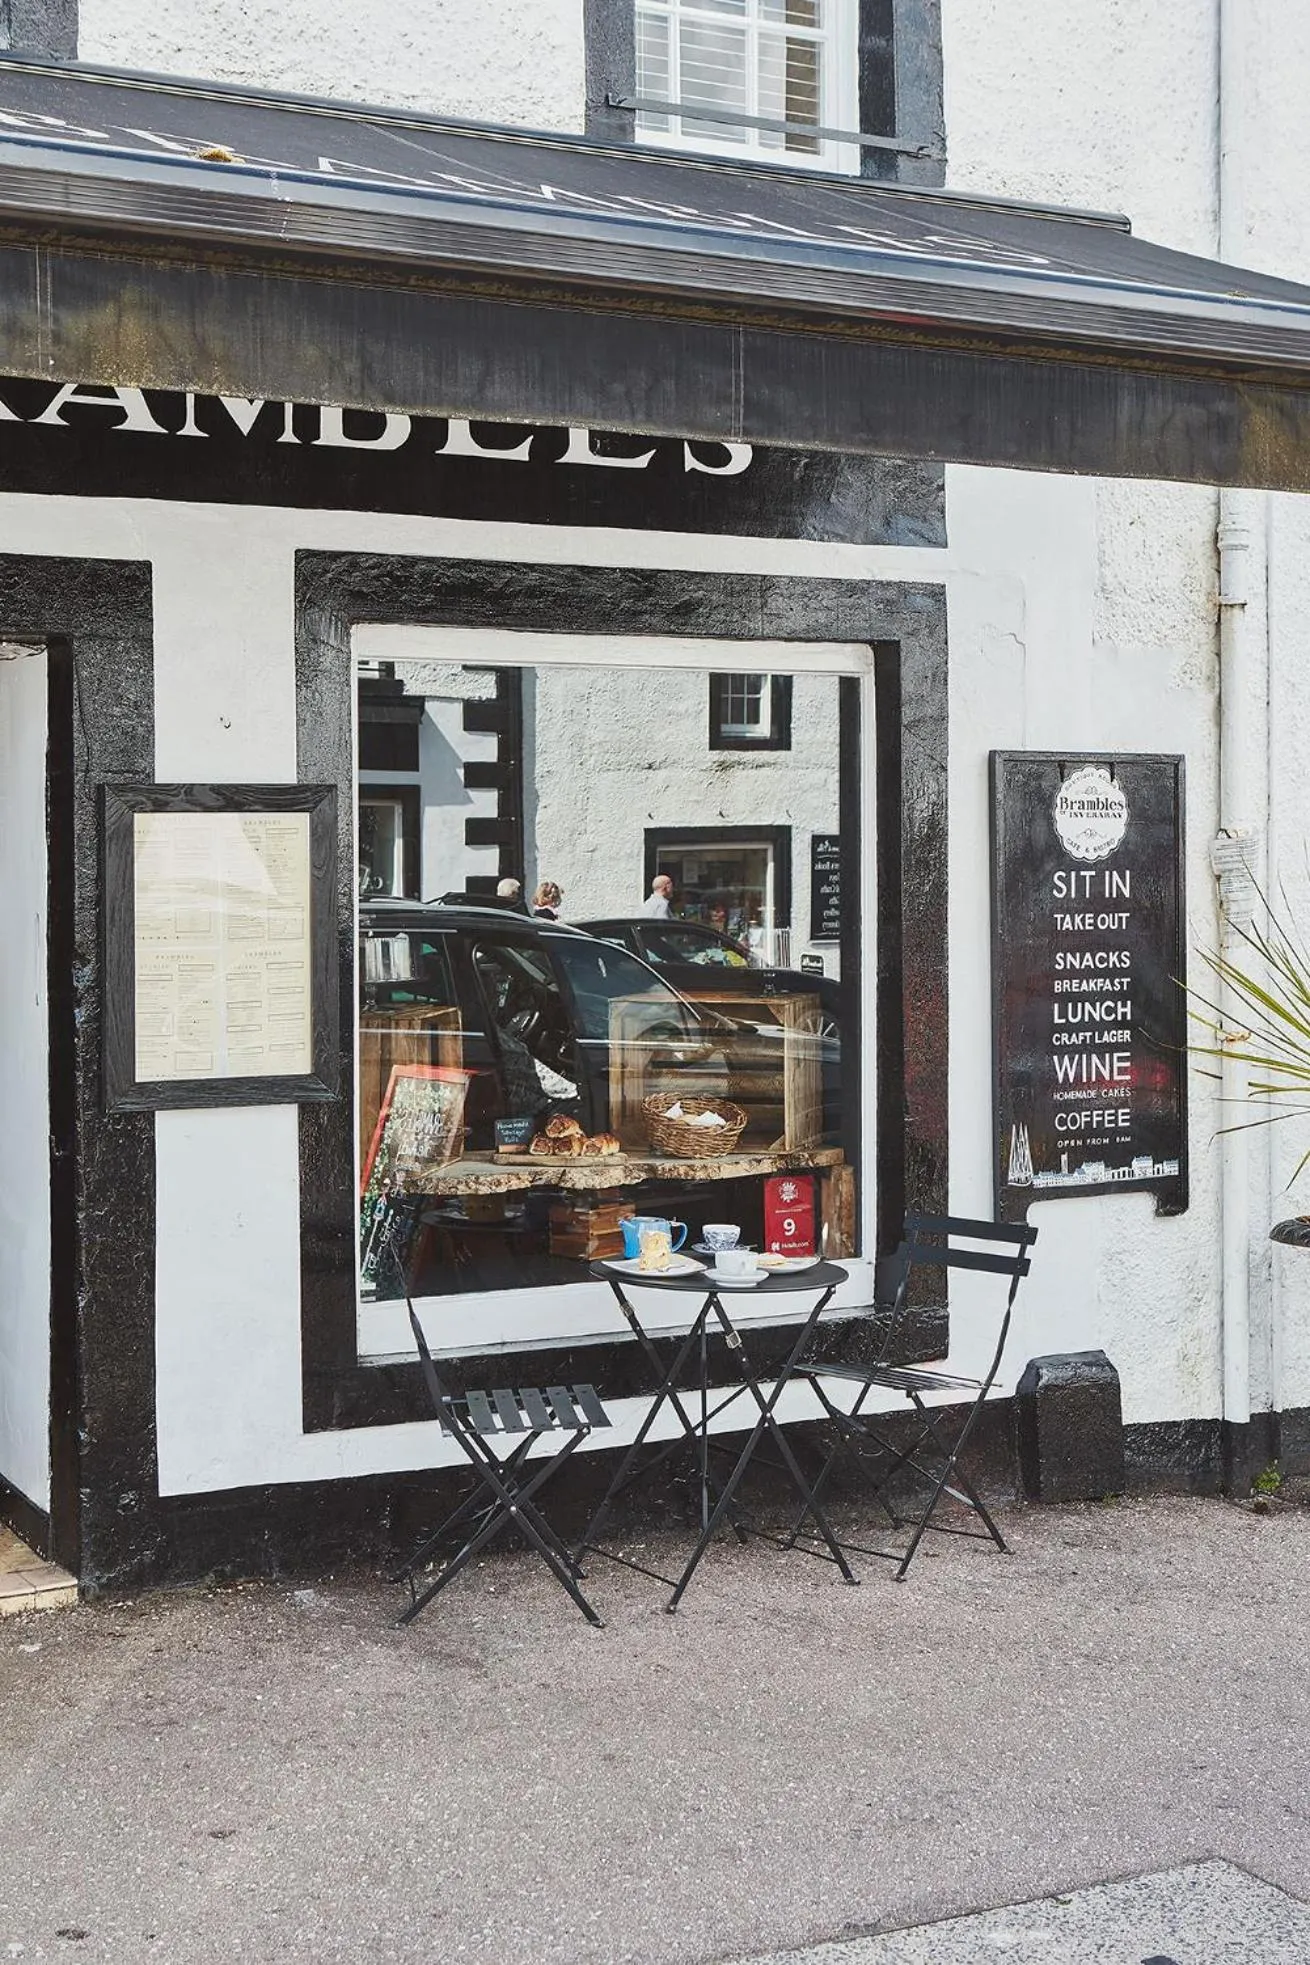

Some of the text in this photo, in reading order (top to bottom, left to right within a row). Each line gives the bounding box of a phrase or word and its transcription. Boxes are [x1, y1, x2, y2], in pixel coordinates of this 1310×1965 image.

[1060, 796, 1125, 811] Brambles
[1053, 870, 1129, 898] SIT IN
[1054, 913, 1129, 930] TAKE OUT
[1056, 952, 1130, 969] SNACKS
[1055, 978, 1130, 992] BREAKFAST
[1054, 1001, 1130, 1023] LUNCH
[1053, 1030, 1131, 1045] CRAFT LAGER
[1053, 1053, 1130, 1083] WINE
[1053, 1087, 1132, 1101] HOMEMADE CAKES
[1055, 1109, 1129, 1130] COFFEE
[784, 1219, 795, 1235] 9
